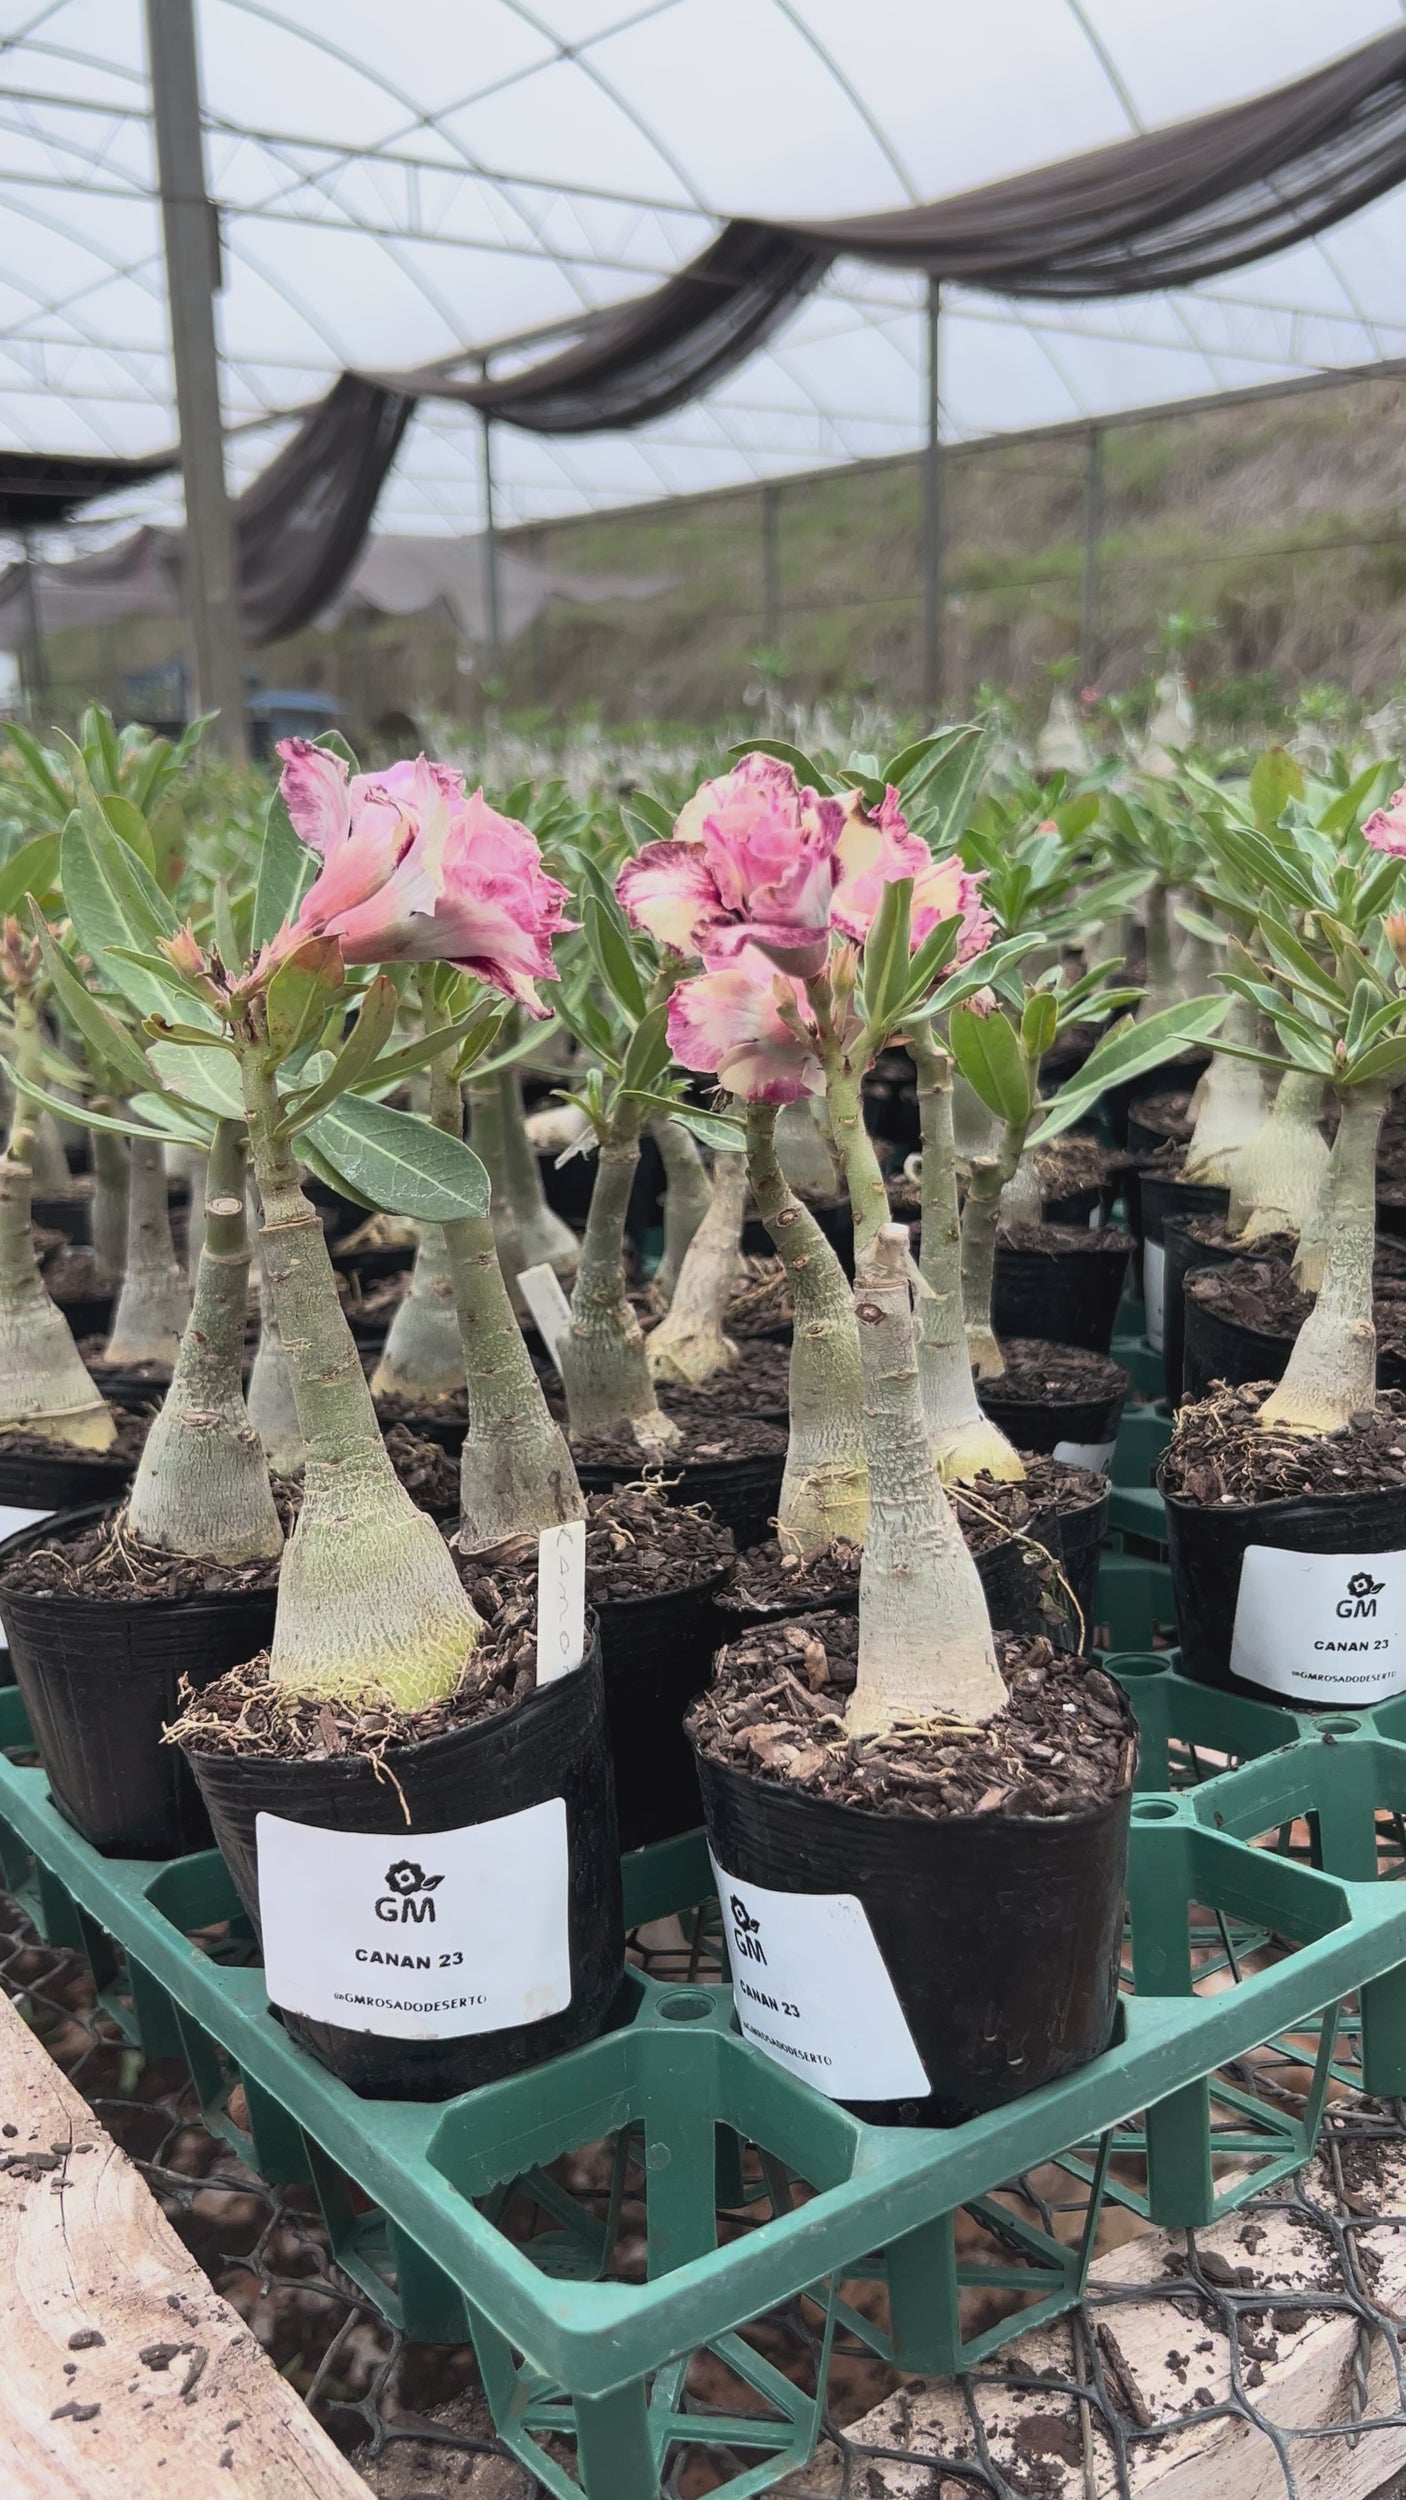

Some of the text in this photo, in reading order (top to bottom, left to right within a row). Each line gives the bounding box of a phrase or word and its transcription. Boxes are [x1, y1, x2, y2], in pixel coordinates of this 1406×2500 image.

[1336, 1598, 1378, 1619] GM
[1313, 1639, 1390, 1652] CANAN 23
[374, 1896, 437, 1924] GM
[355, 1948, 465, 1970] CANAN 23
[733, 1927, 769, 1967] GM
[739, 1979, 801, 2019] CANAN 23
